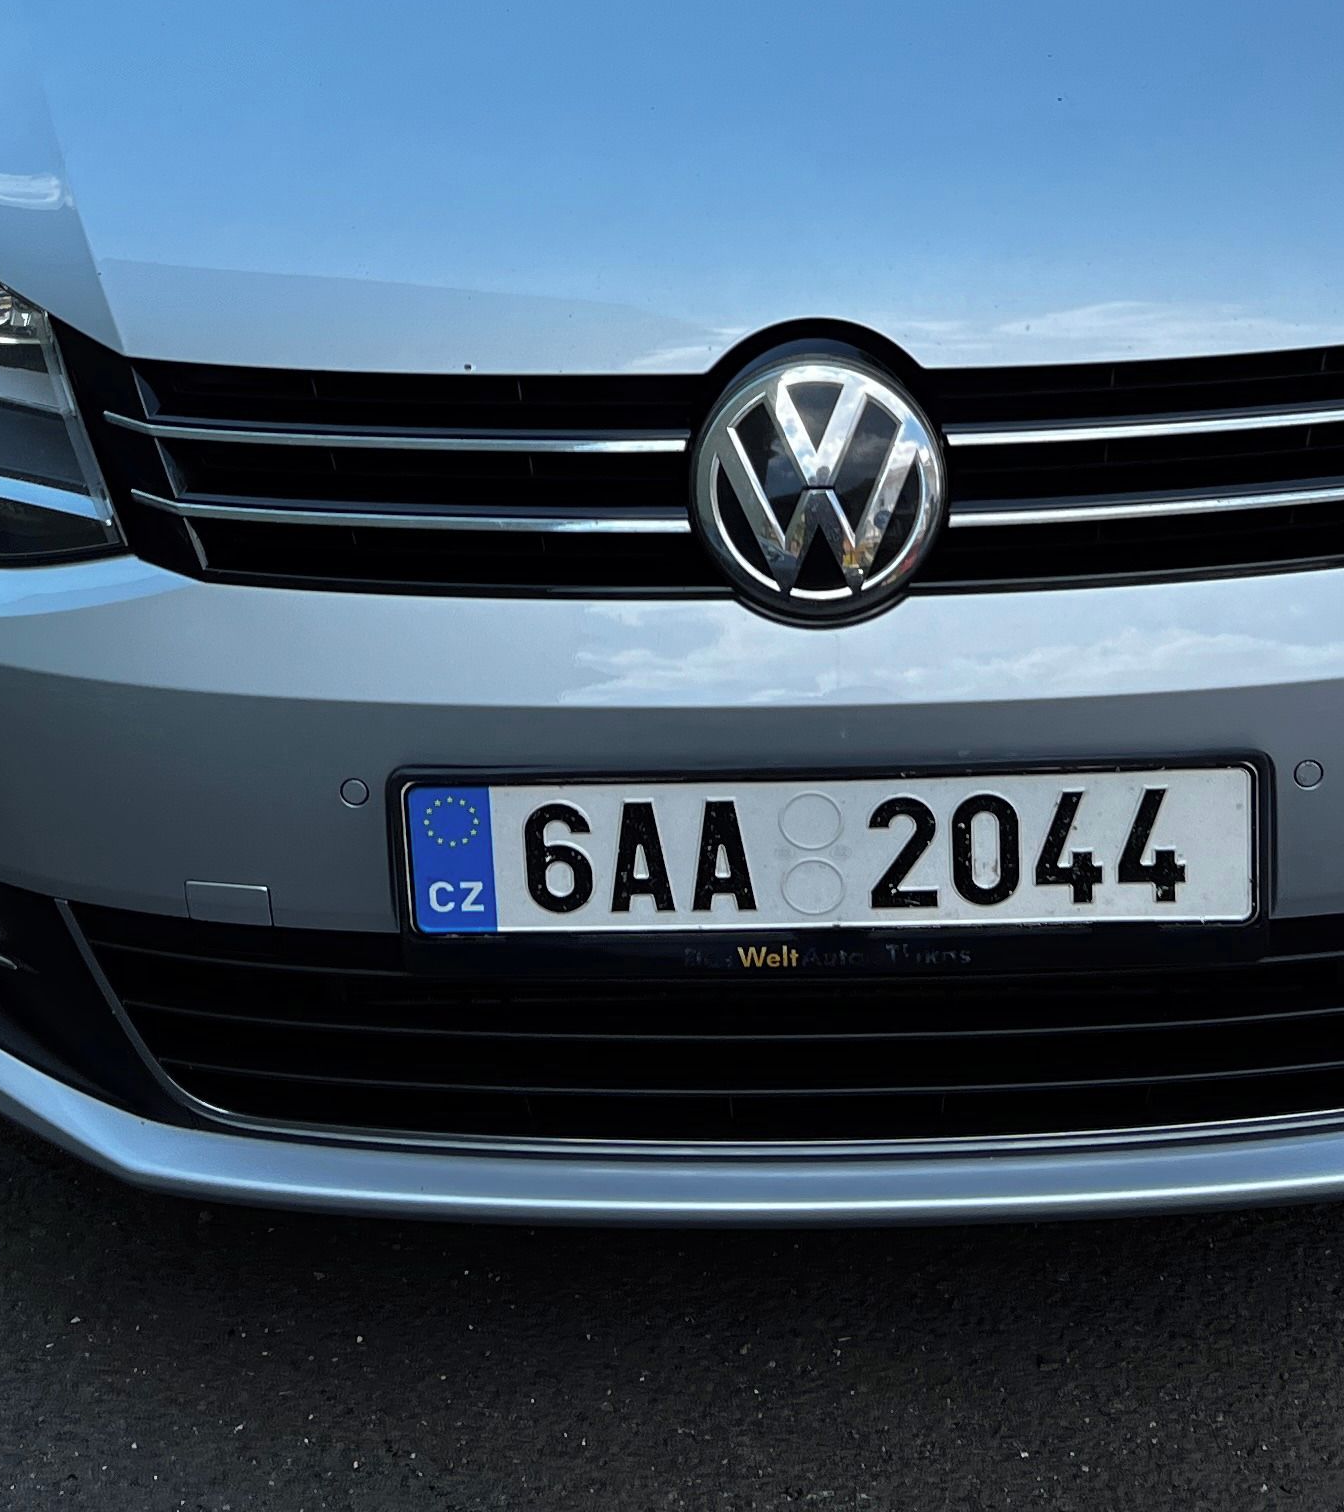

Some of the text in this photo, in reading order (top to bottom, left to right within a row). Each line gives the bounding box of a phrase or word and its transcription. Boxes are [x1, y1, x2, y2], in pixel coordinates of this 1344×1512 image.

[428, 788, 1188, 914] CZ 6AA 2044
